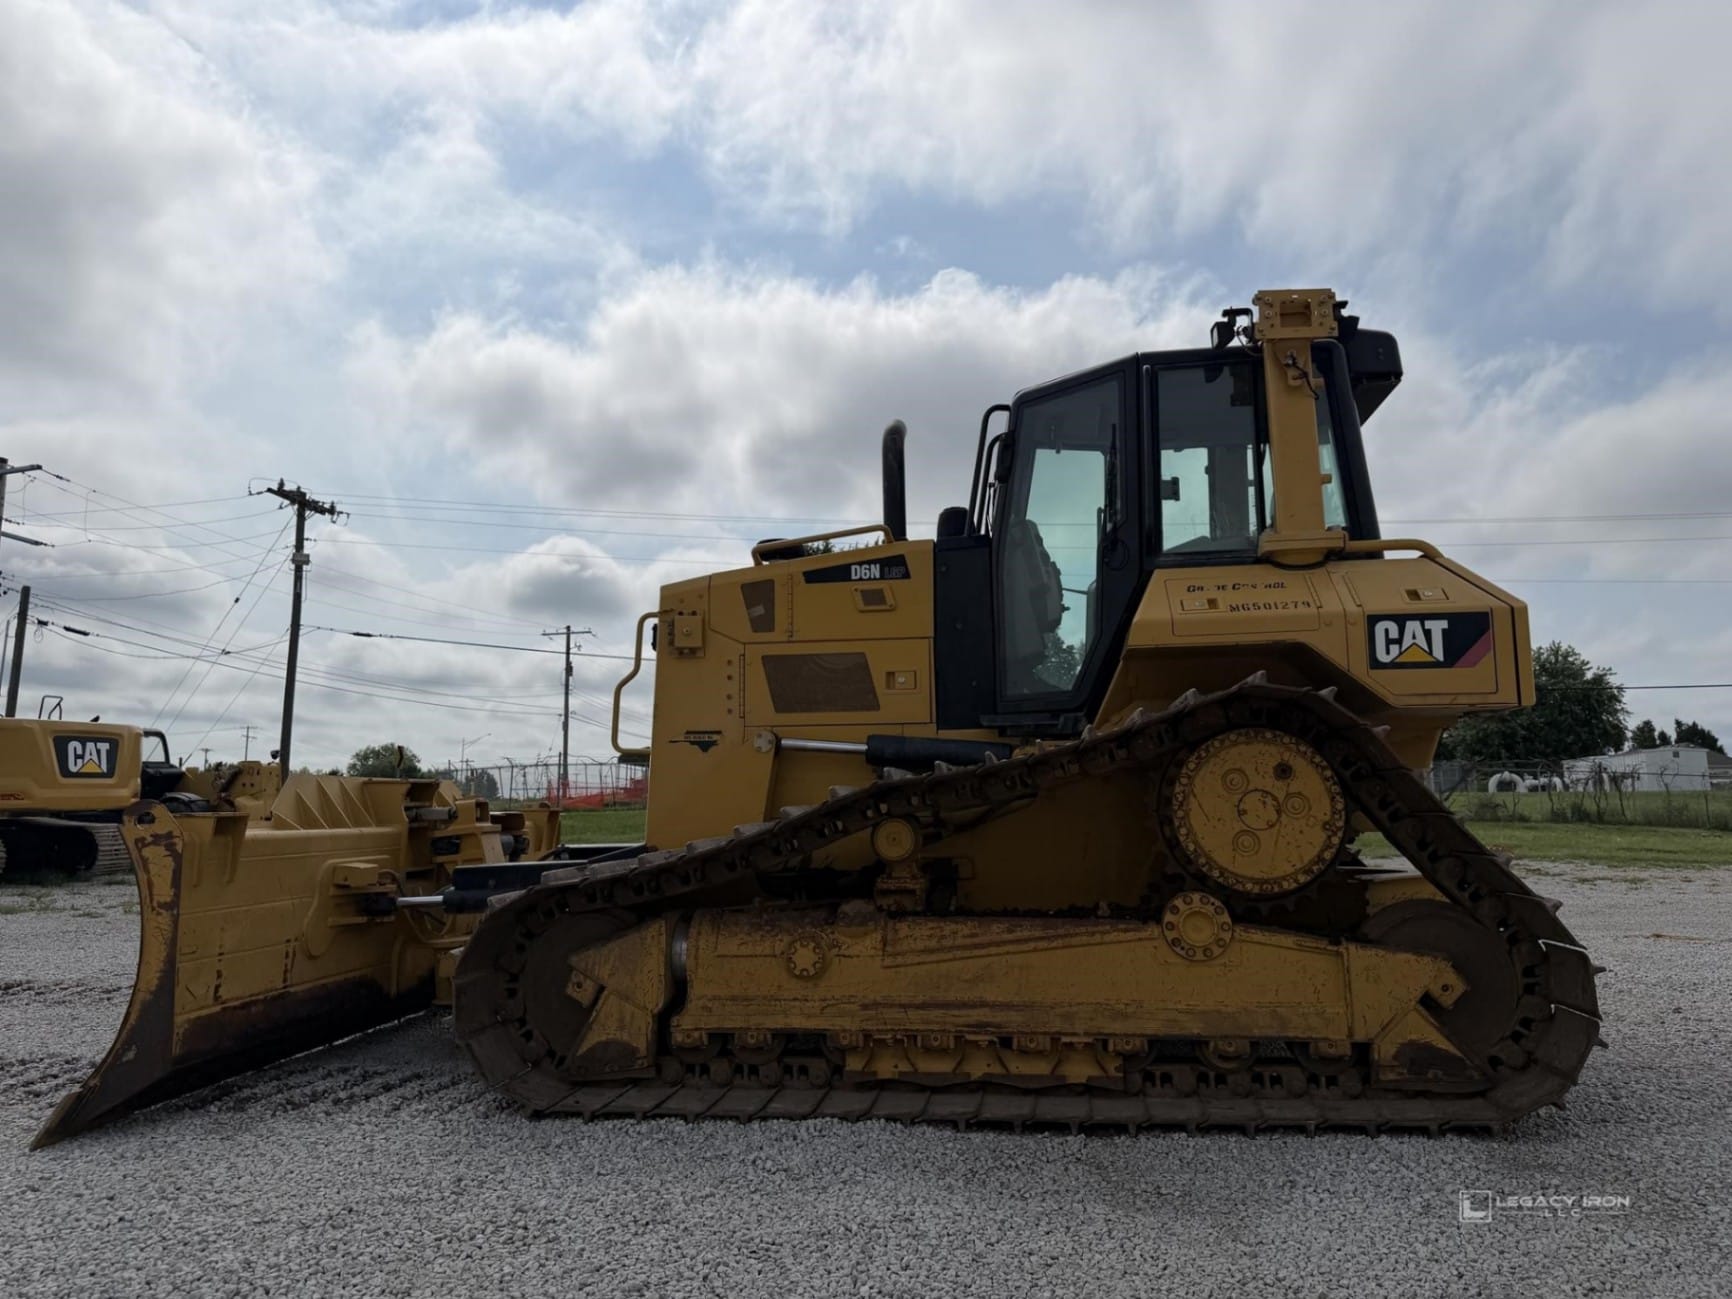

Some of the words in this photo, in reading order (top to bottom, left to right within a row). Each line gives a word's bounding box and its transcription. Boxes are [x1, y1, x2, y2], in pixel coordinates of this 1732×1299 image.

[850, 563, 881, 580] D6N
[1373, 619, 1448, 663] CAT
[67, 740, 110, 774] CAT
